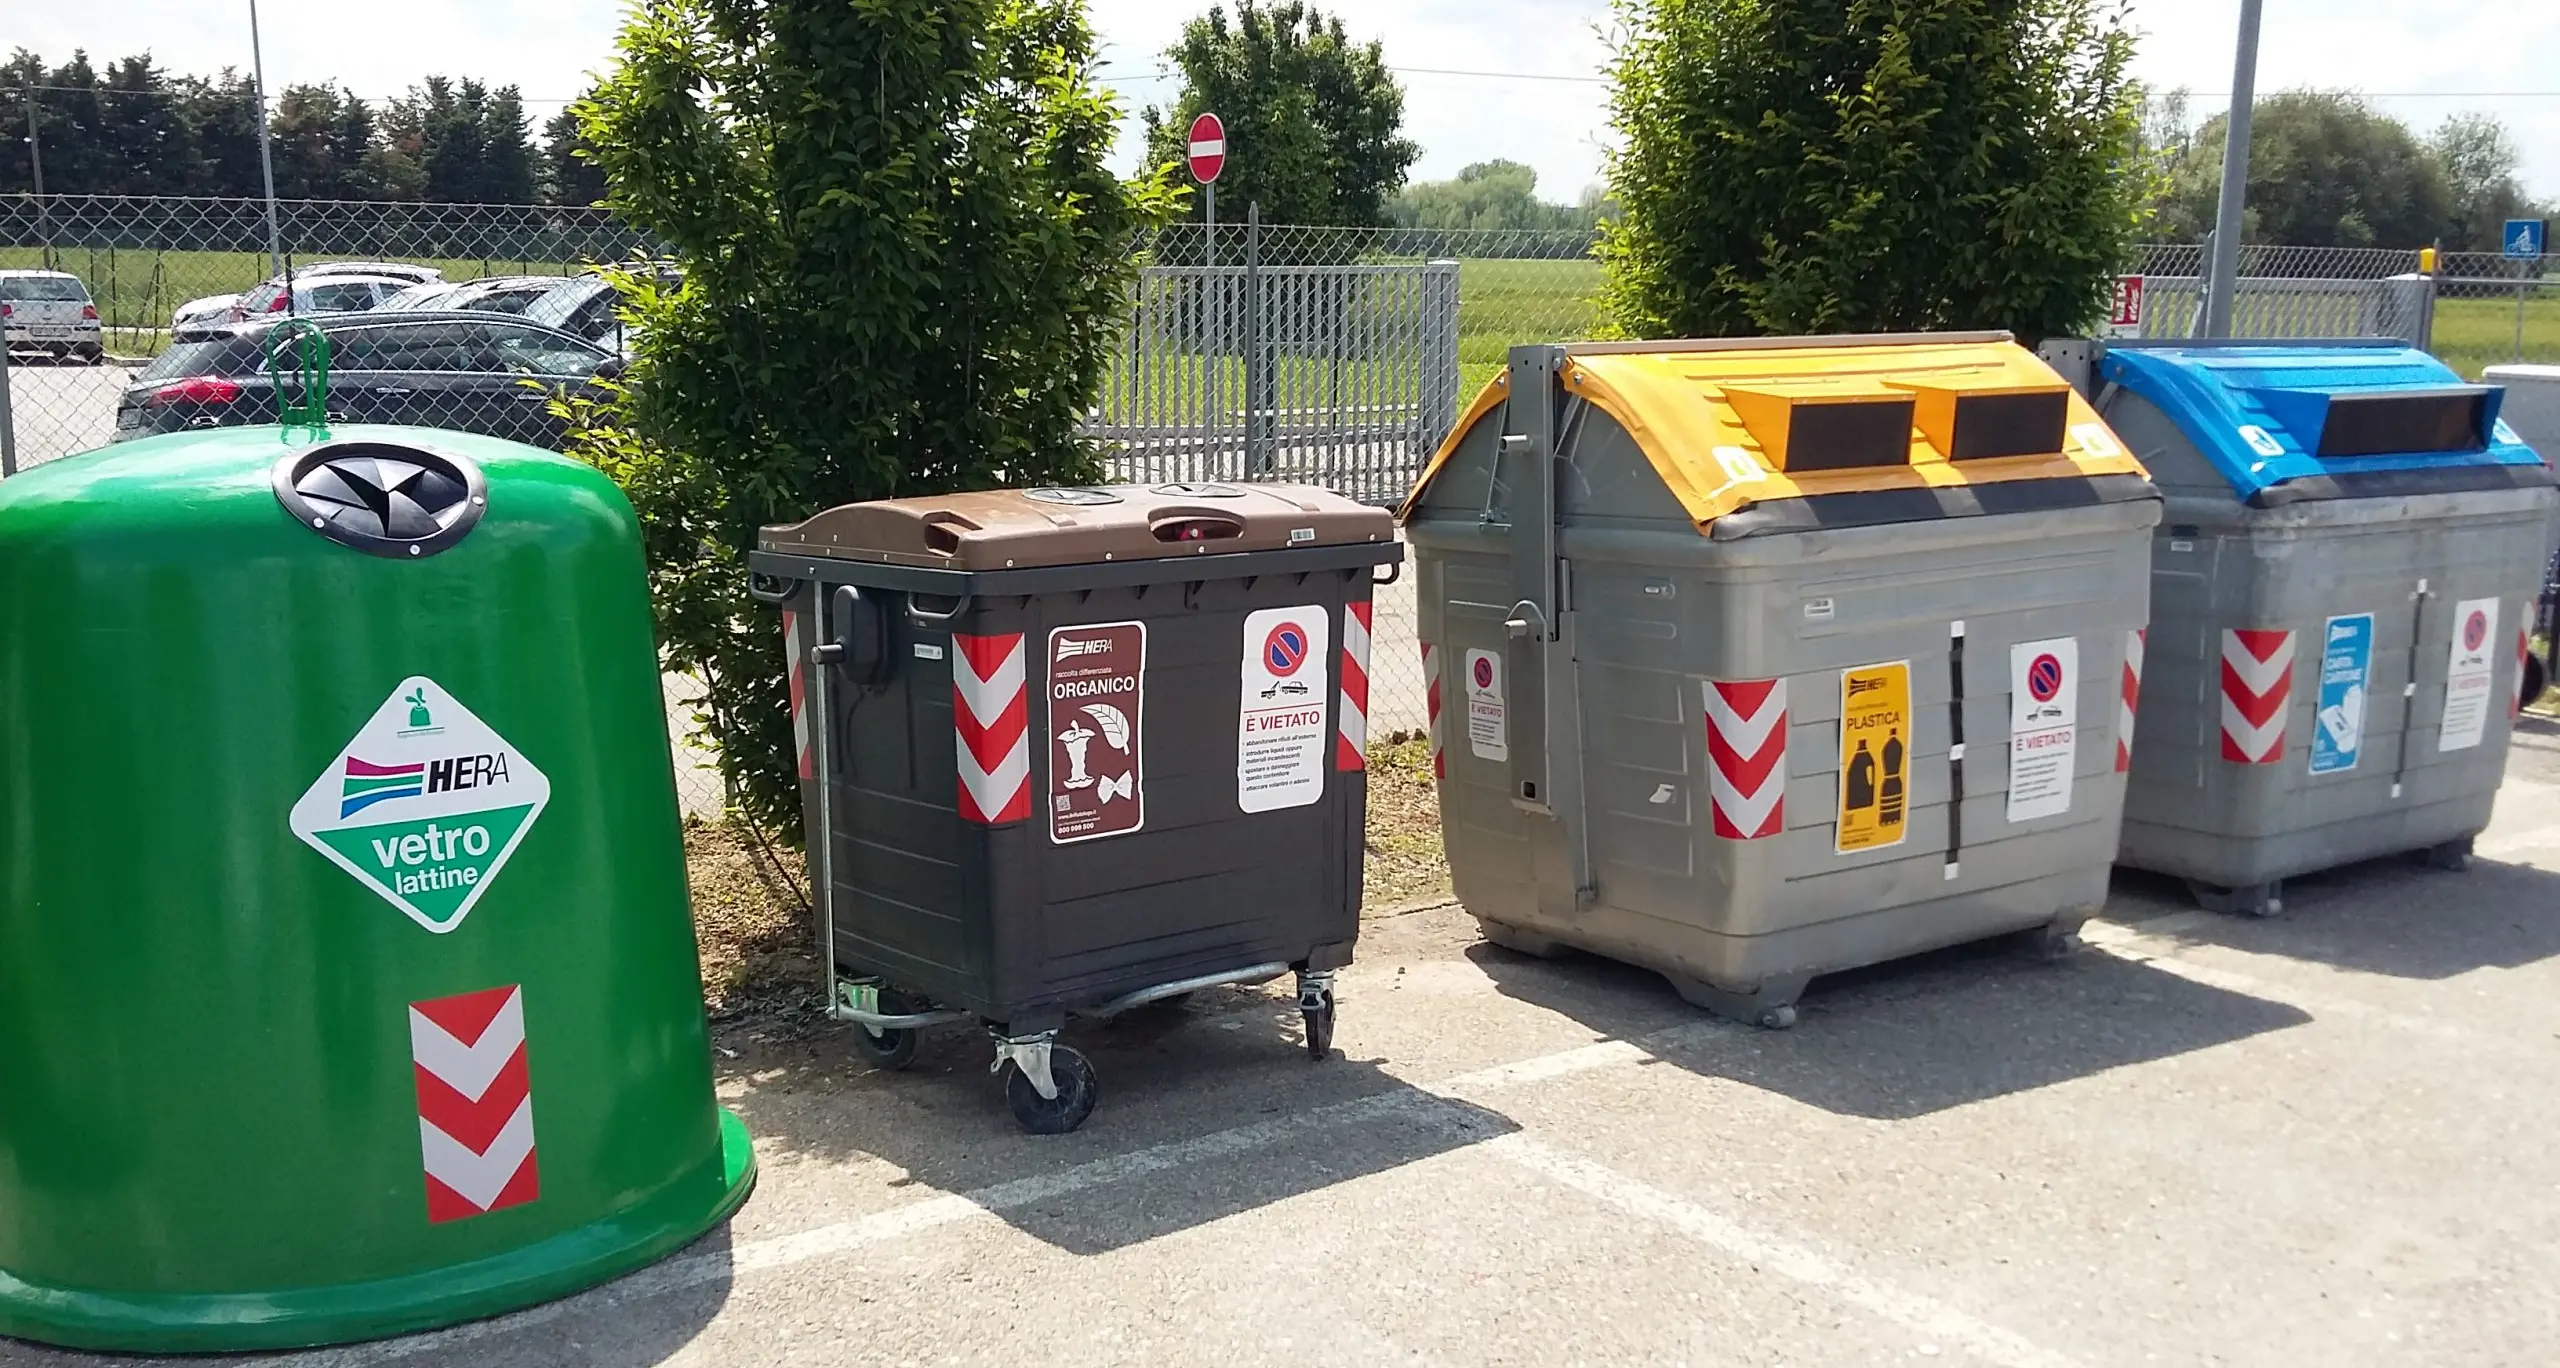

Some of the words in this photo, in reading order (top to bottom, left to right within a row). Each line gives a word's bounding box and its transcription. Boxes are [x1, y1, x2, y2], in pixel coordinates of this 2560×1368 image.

[1084, 638, 1113, 654] HERA
[1056, 669, 1078, 678] raccolta
[1079, 667, 1112, 676] differenziata
[1054, 676, 1135, 699] ORGANICO
[1246, 714, 1256, 732] È
[1260, 710, 1320, 731] VIETATO
[1477, 705, 1503, 717] VIETATO
[1847, 711, 1900, 732] PLASTICA
[2016, 735, 2023, 751] È
[2027, 731, 2072, 749] VIETATO
[427, 752, 510, 794] HERA
[371, 823, 490, 868] vetro
[395, 866, 478, 895] lattine
